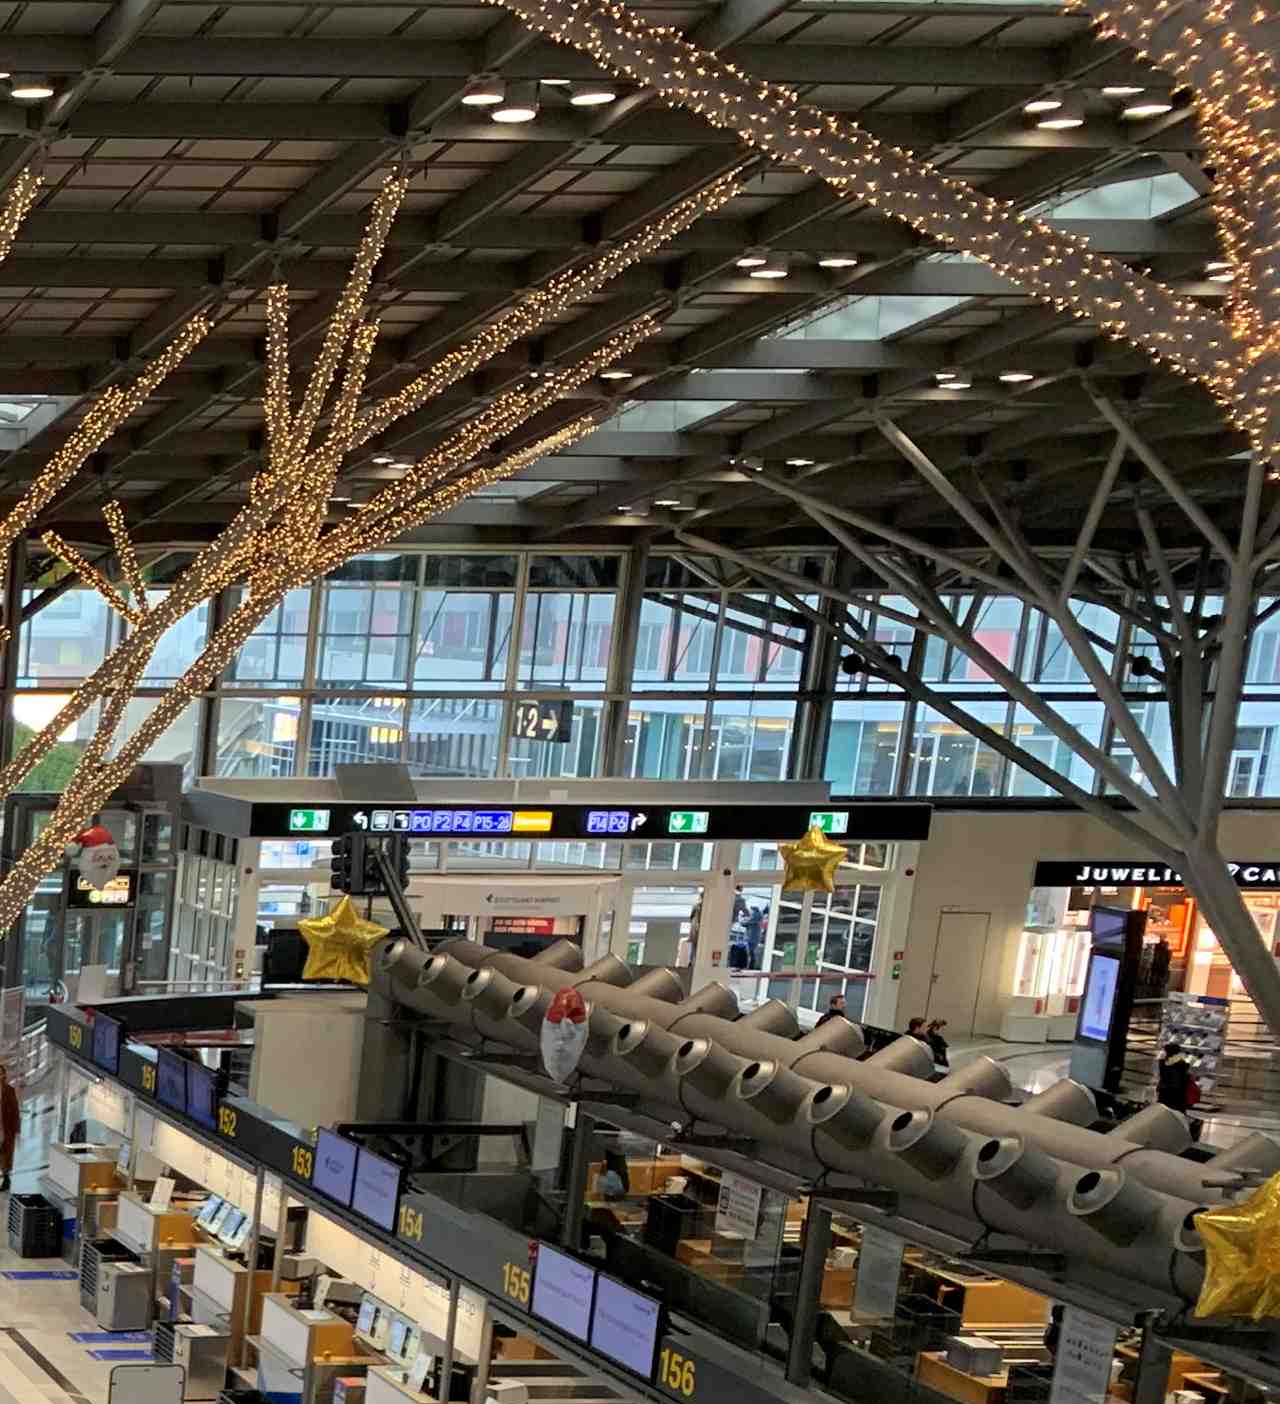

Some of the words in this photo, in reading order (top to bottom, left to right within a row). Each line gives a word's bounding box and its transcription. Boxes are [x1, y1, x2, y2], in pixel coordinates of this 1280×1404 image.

[1076, 866, 1182, 881] JUWELI
[68, 1024, 83, 1049] 150
[142, 1064, 157, 1091] 151
[218, 1105, 238, 1137] 152
[292, 1146, 313, 1179] 153
[399, 1203, 423, 1243] 154
[503, 1262, 531, 1303] 155
[659, 1348, 696, 1396] 156
